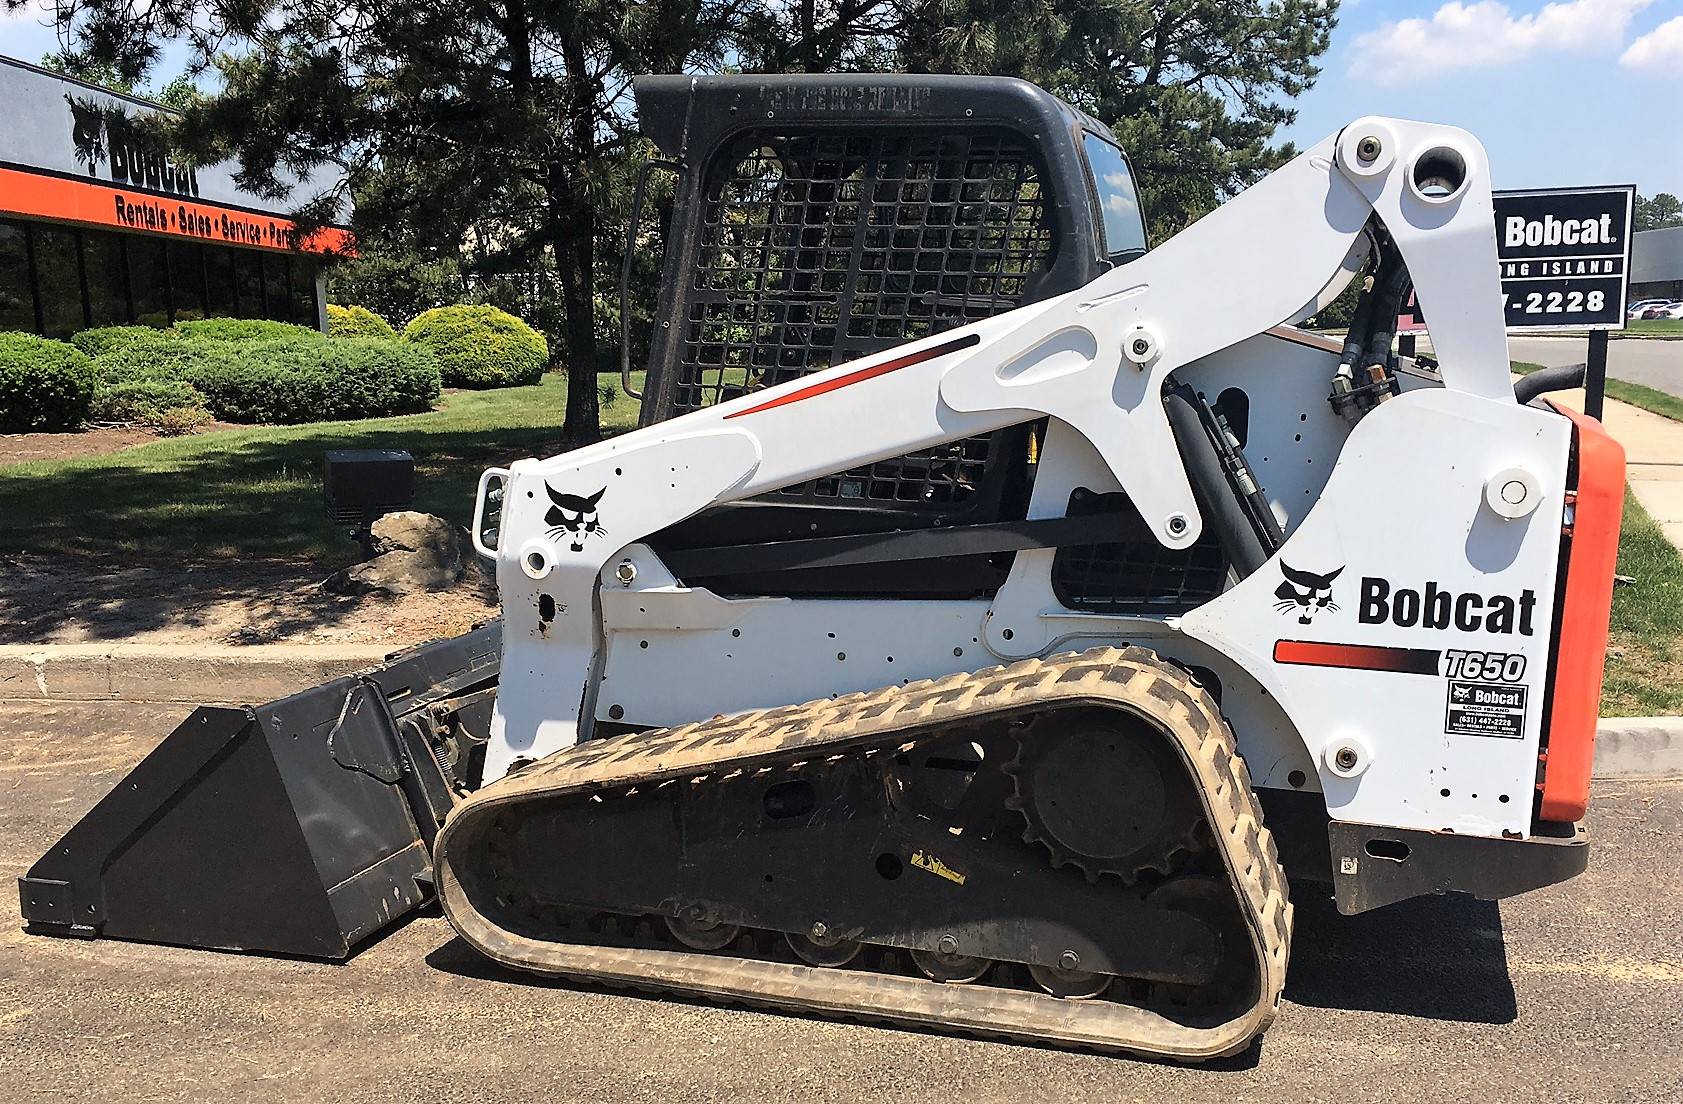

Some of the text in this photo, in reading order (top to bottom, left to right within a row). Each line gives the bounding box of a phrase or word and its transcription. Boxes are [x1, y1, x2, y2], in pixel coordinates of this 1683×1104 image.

[114, 194, 291, 249] Rentals Sales Service Part
[1505, 213, 1613, 247] Bobcat
[1500, 260, 1613, 277] NG ISLAND
[1502, 290, 1605, 314] -2228
[1358, 576, 1537, 636] Bobcat
[1445, 649, 1527, 682] T650
[1475, 689, 1519, 705] Bobcat
[1459, 715, 1477, 725] (631)
